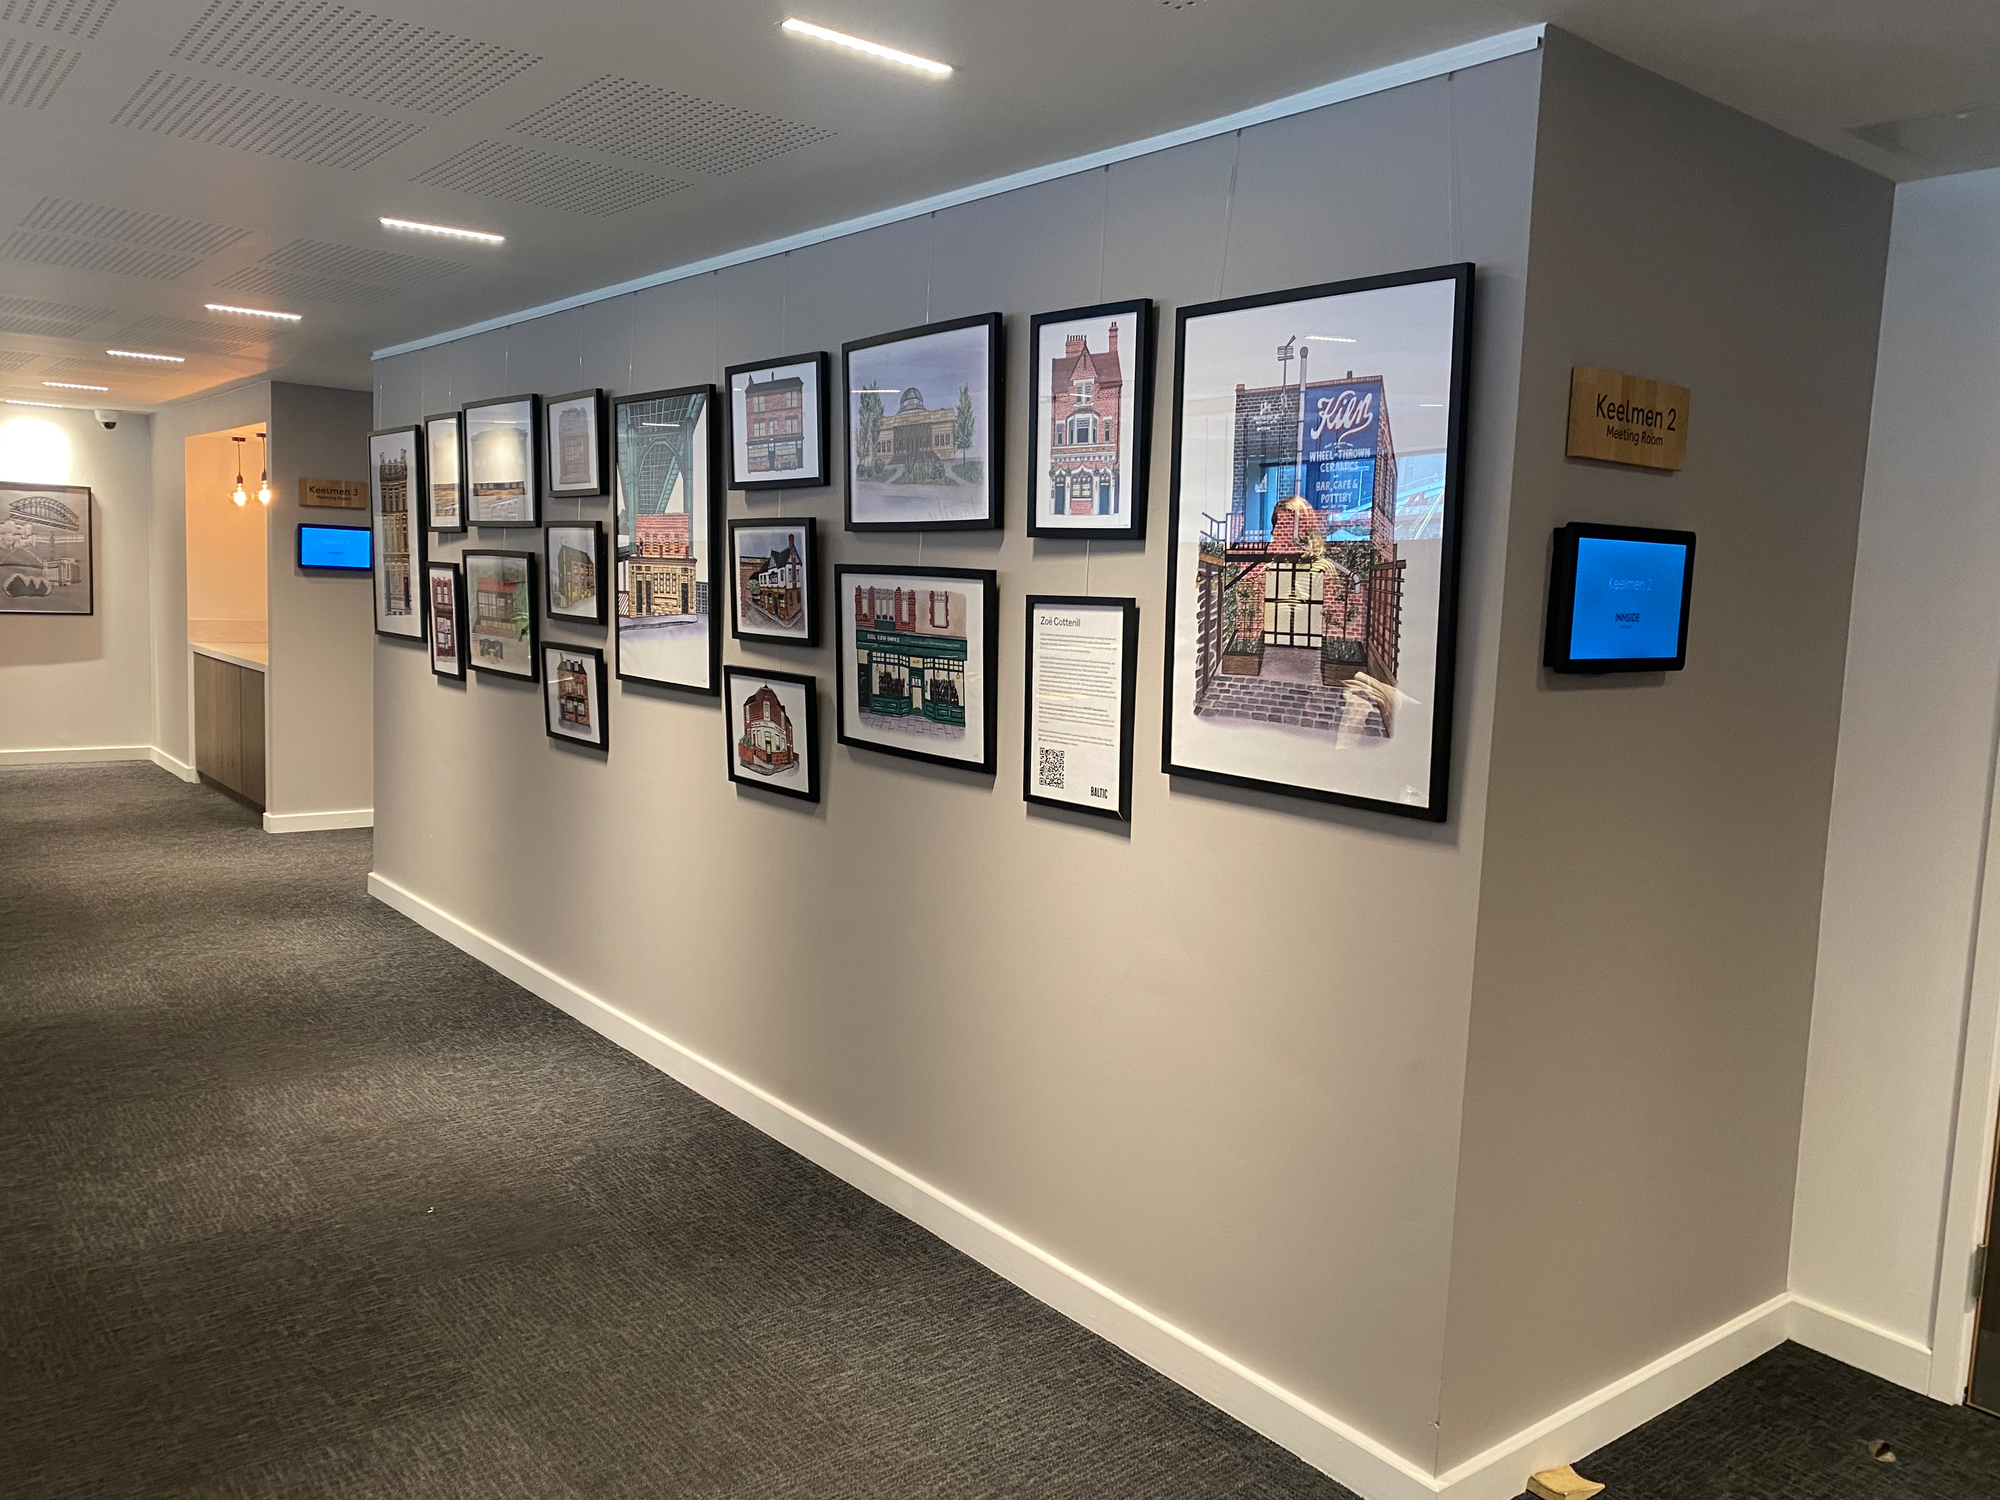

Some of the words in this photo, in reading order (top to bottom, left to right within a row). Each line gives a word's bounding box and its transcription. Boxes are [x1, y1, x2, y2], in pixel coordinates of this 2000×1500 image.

[1310, 390, 1374, 443] Kiln
[1596, 393, 1663, 429] Keelmen
[1667, 408, 1676, 431] 2
[1606, 425, 1639, 446] Meeting
[1641, 431, 1664, 447] Room
[1309, 448, 1371, 463] WHEEL-THROWN
[1320, 461, 1359, 473] CERAMICS
[308, 485, 351, 496] Keelmen
[352, 488, 359, 497] 3
[1320, 492, 1353, 504] POTTERY
[1608, 576, 1645, 591] Keelmen
[1646, 577, 1653, 591] 2
[1614, 612, 1641, 623] INNSIDE
[1090, 785, 1109, 800] BALTIC
